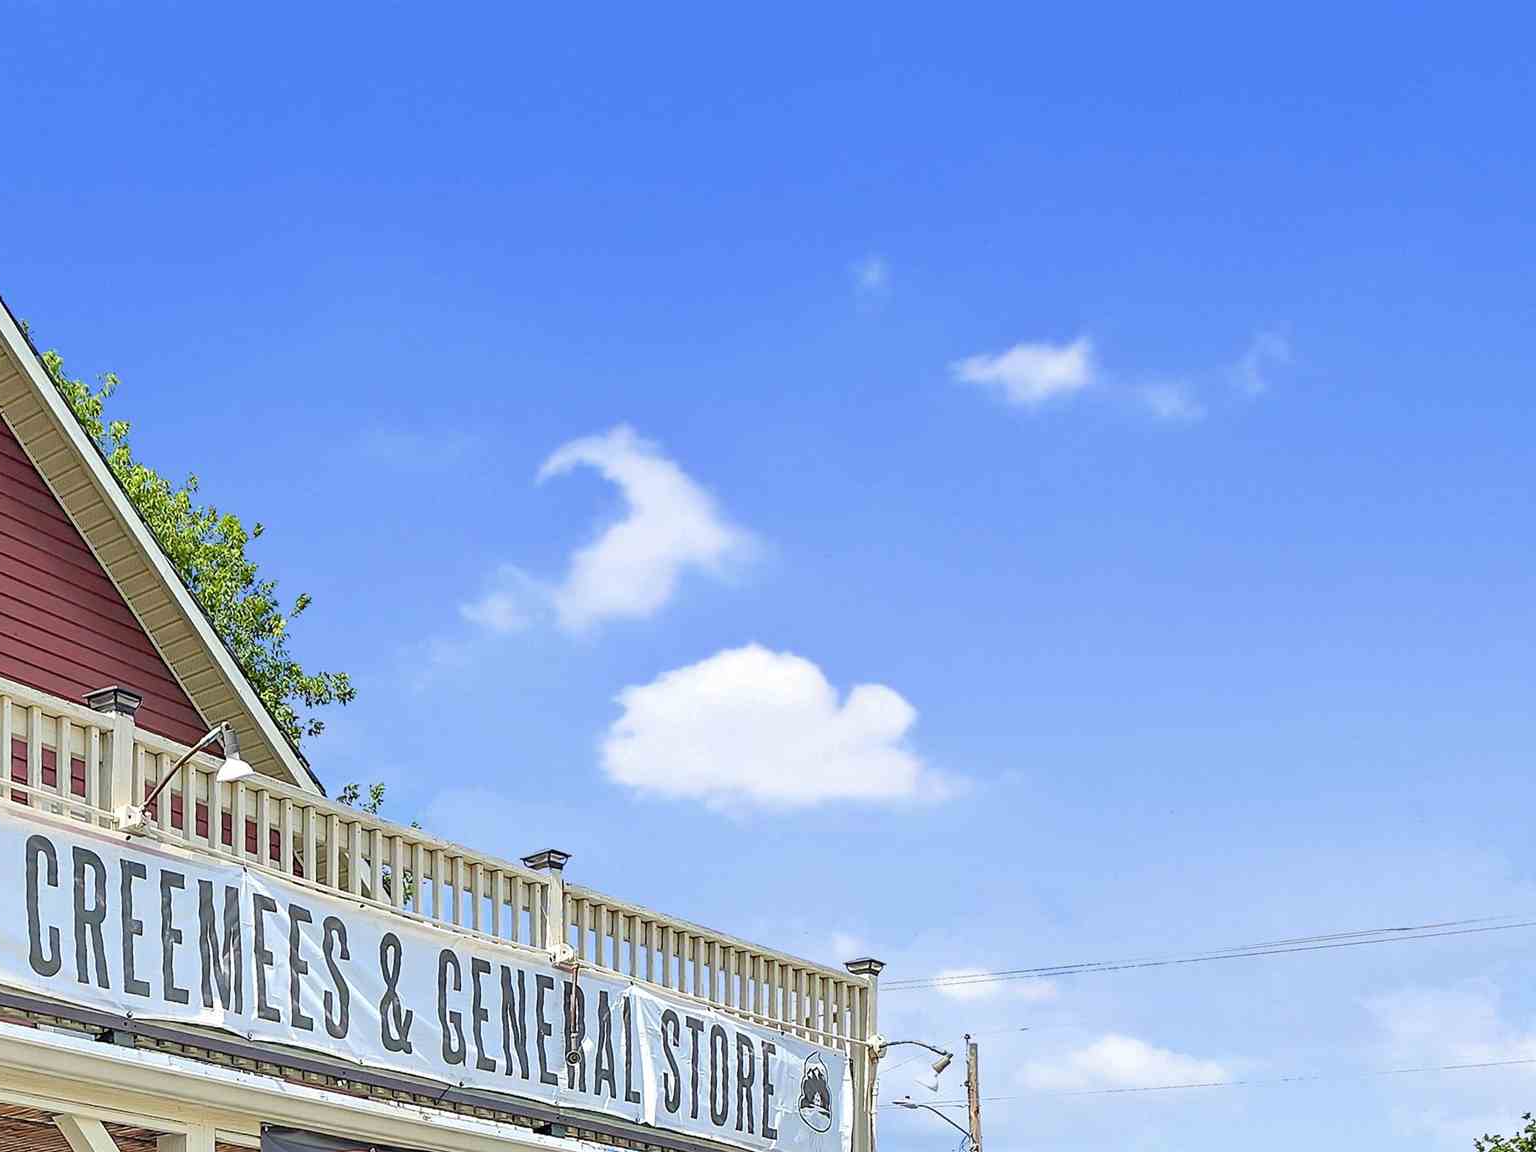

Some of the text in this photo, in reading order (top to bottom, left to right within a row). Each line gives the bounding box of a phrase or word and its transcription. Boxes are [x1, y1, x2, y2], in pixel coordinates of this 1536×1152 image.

[25, 834, 351, 1040] CREEMEES
[378, 931, 414, 1055] &
[437, 948, 642, 1105] GENERAL
[660, 1008, 778, 1141] STORE
